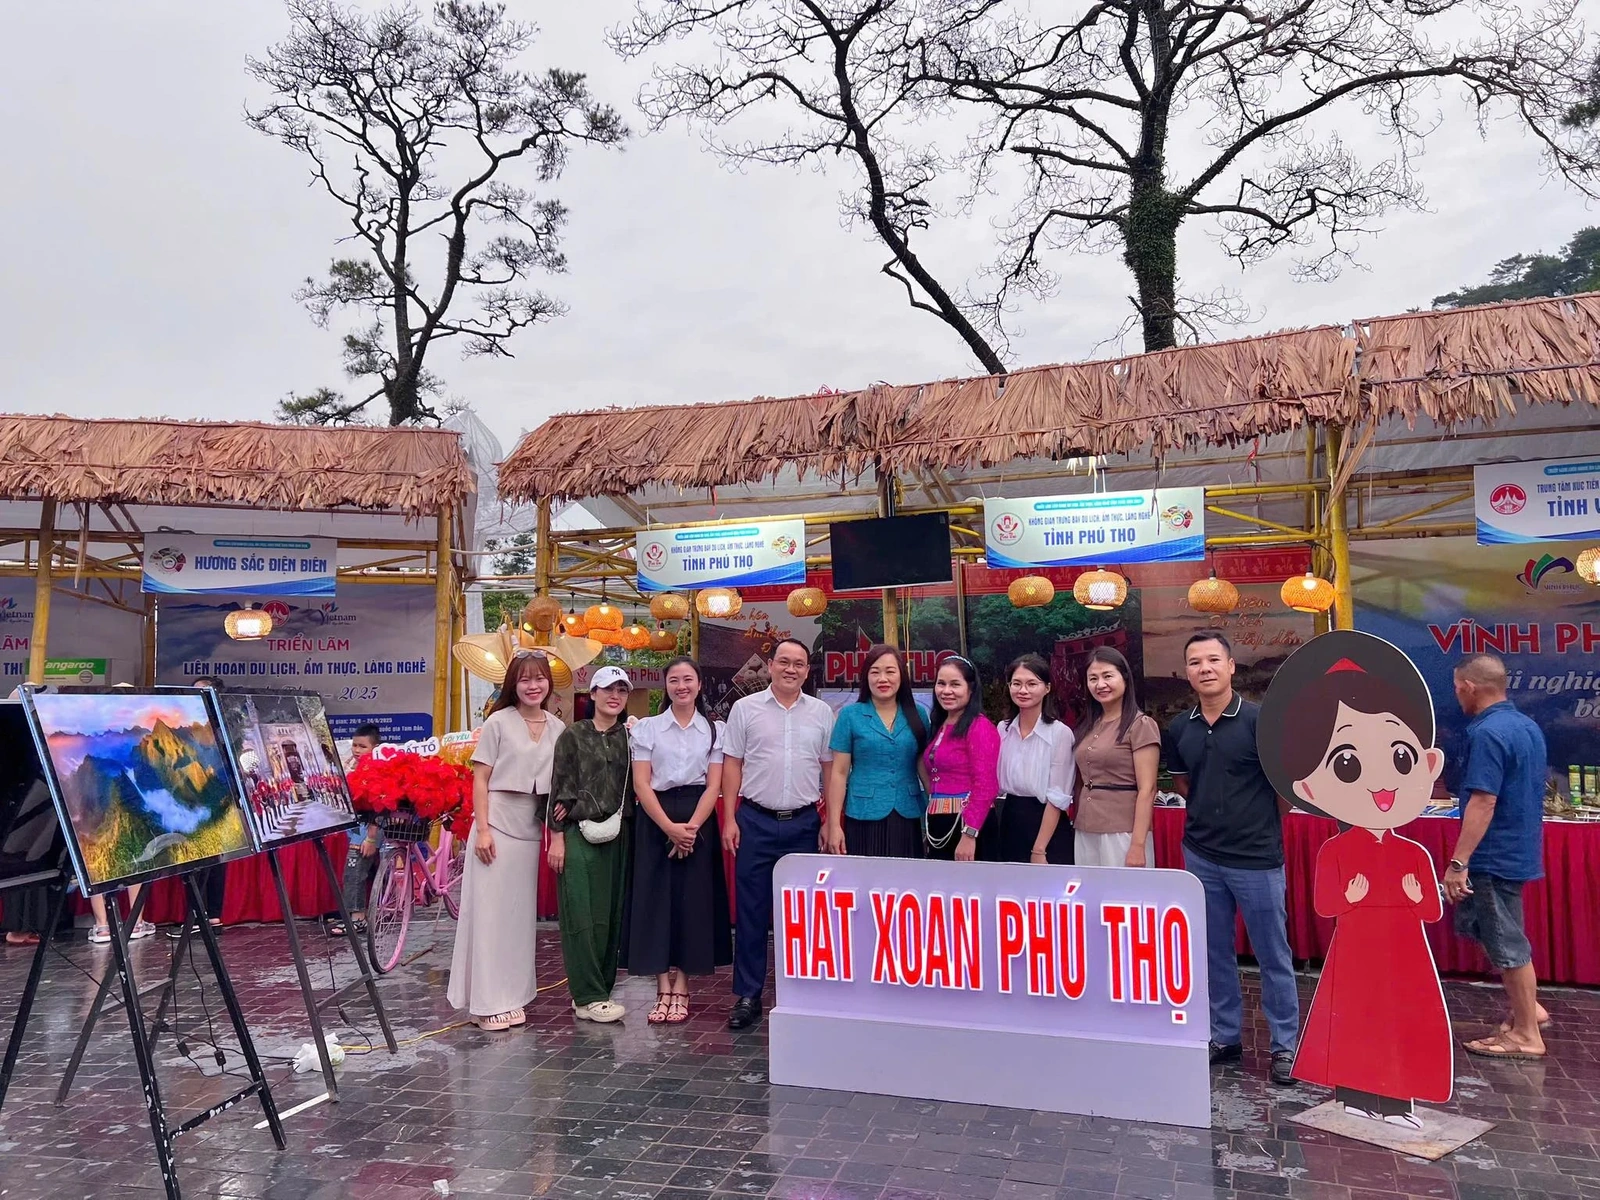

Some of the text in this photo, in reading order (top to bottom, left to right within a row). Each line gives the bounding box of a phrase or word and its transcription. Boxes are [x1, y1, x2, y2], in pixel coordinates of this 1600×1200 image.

[1547, 496, 1588, 517] TỈNH
[1044, 526, 1136, 546] TỈNH PHÚ THỌ
[194, 552, 327, 574] HƯƠNG SẮC ĐIỆN BIÊN
[710, 553, 730, 568] PHÚ
[734, 555, 754, 570] THỌ
[0, 634, 28, 650] ÃM
[266, 632, 350, 651] TRIỂN LÃM
[1427, 618, 1541, 654] VĨNH
[44, 660, 94, 670] angaroo
[184, 656, 426, 678] LIÊN HOAN DU LỊCH, ẨM THỰC, LÀNG NGHỀ
[825, 642, 870, 682] PH
[640, 668, 660, 682] Phú
[338, 686, 378, 700] 2025
[421, 740, 436, 752] TỔ
[781, 868, 1193, 1025] HÁT XOAN PHÚ THỌ
